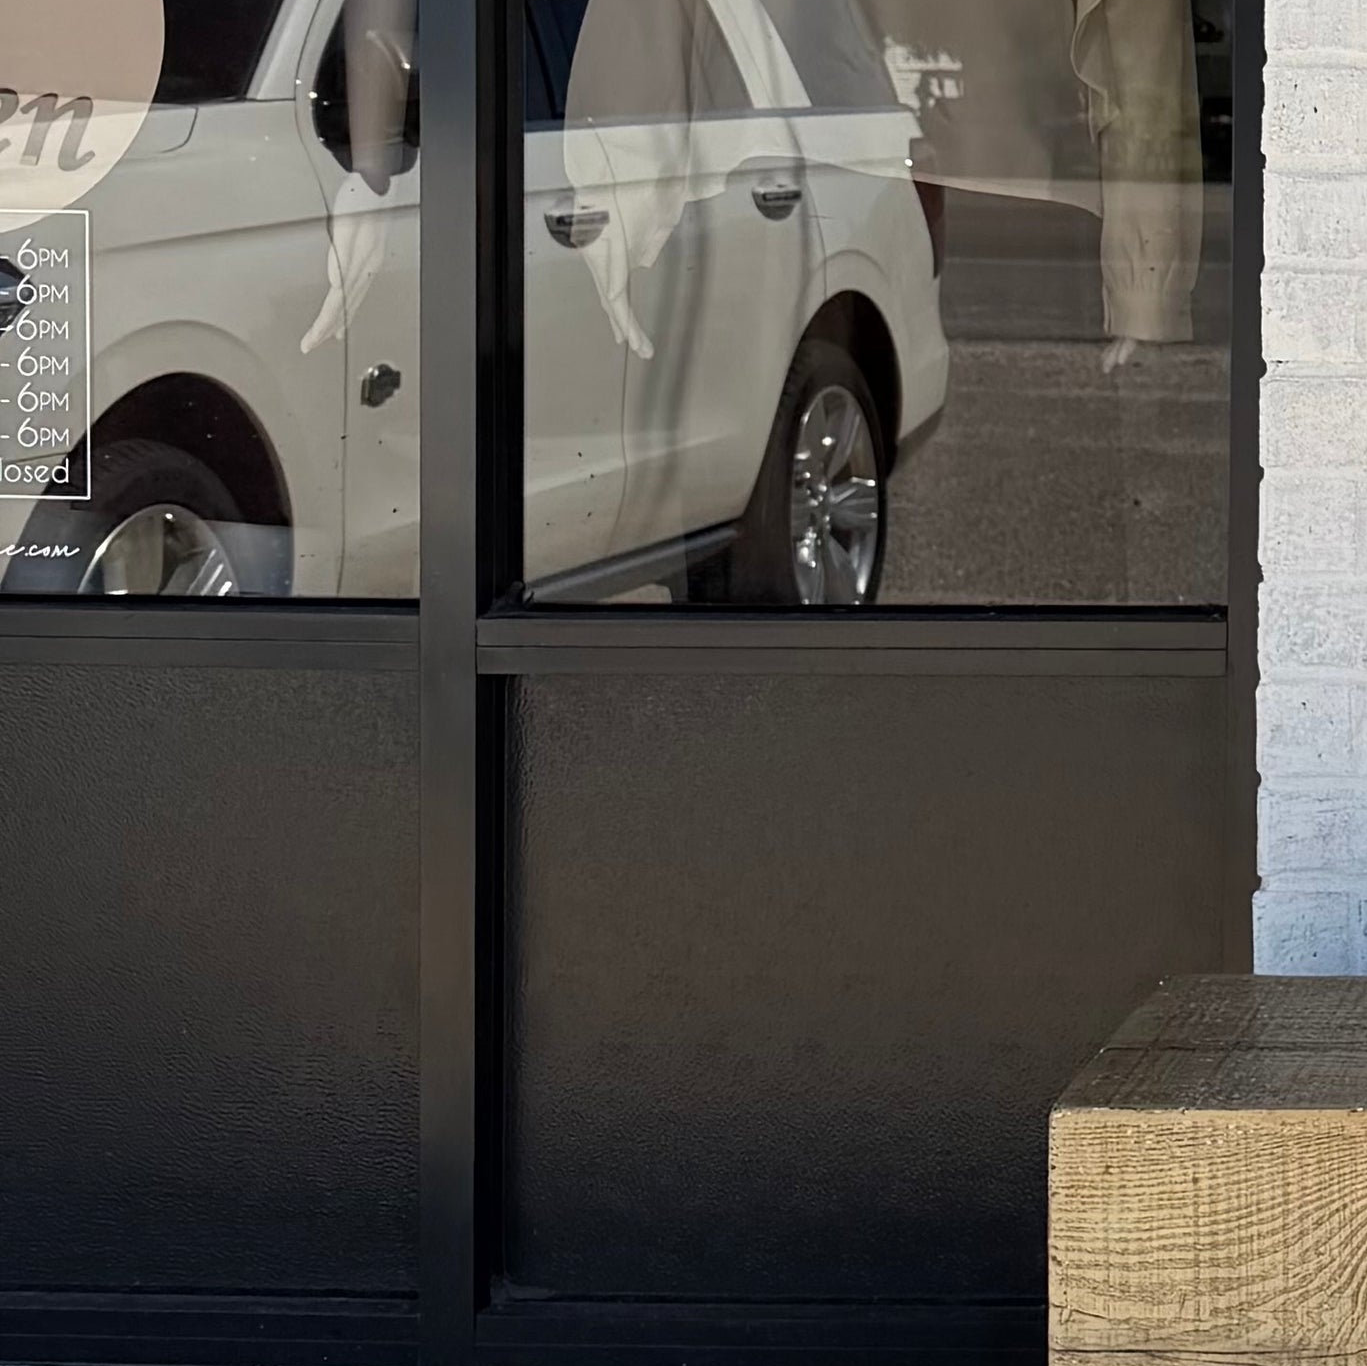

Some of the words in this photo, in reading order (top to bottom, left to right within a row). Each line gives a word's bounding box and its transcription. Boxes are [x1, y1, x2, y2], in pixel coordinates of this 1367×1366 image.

[17, 238, 69, 270] 6PM
[17, 274, 69, 305] 6PM
[17, 309, 69, 341] 6PM
[17, 346, 69, 377] 6PM
[17, 382, 69, 413] 6PM
[17, 417, 69, 448] 6PM
